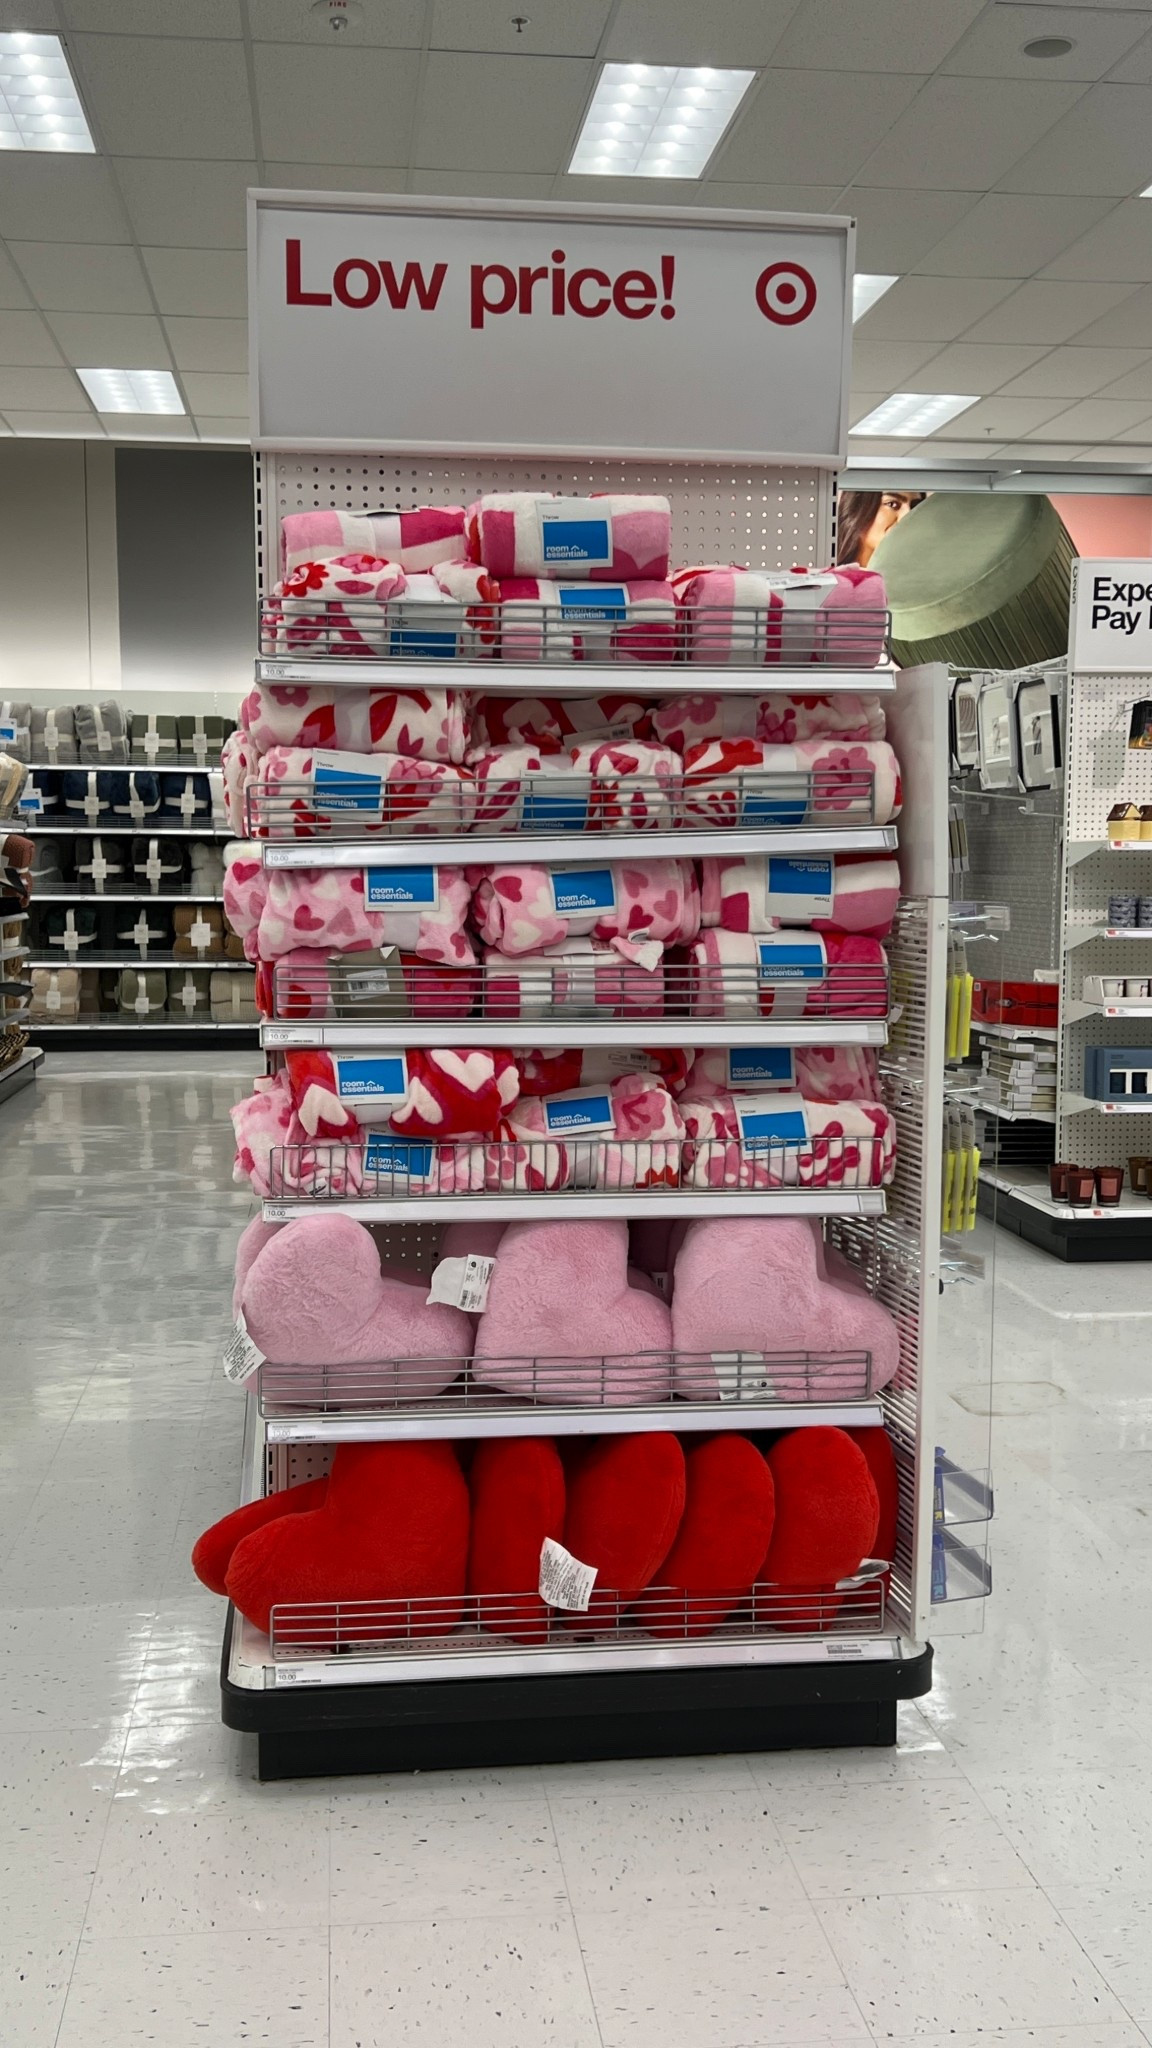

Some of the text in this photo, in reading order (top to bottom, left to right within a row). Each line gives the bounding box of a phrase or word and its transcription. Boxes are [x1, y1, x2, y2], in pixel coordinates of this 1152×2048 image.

[285, 239, 676, 329] Low price!
[546, 545, 569, 553] room
[546, 549, 588, 558] essentials
[564, 611, 606, 619] essentials
[1092, 605, 1142, 635] Pay
[371, 891, 413, 900] essentials
[558, 897, 596, 908] essentials
[764, 968, 804, 976] essentials
[732, 1069, 772, 1078] essentials
[342, 1084, 384, 1093] essentials
[550, 1116, 591, 1127] essentials
